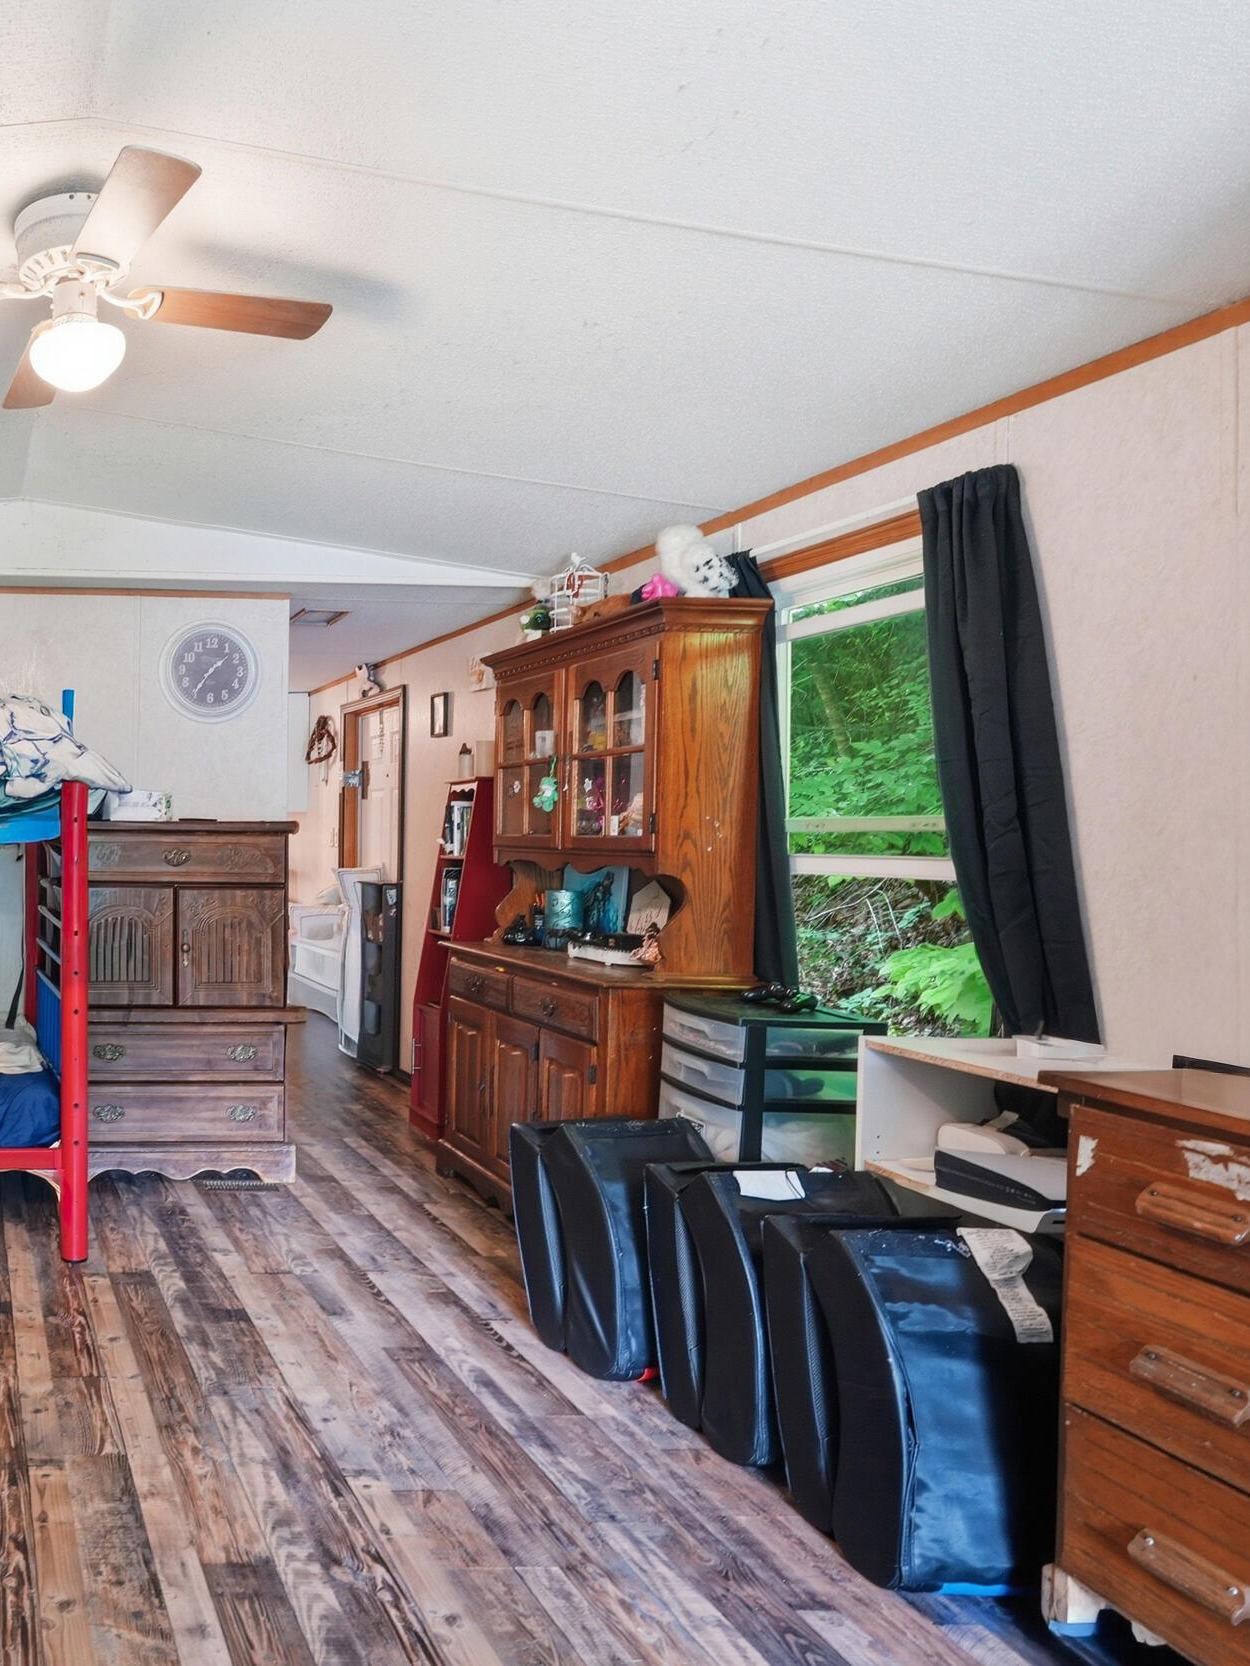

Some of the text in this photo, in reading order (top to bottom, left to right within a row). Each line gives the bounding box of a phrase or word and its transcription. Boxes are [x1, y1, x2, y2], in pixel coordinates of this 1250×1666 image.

[194, 642, 203, 652] 11
[206, 638, 218, 648] 12
[224, 643, 230, 653] 1
[183, 652, 195, 663] 10
[232, 653, 239, 663] 2
[179, 664, 185, 675] 9
[237, 666, 243, 677] 3
[182, 677, 189, 687] 8
[232, 679, 238, 689] 4
[207, 693, 213, 703] 6
[221, 690, 228, 700] 5
